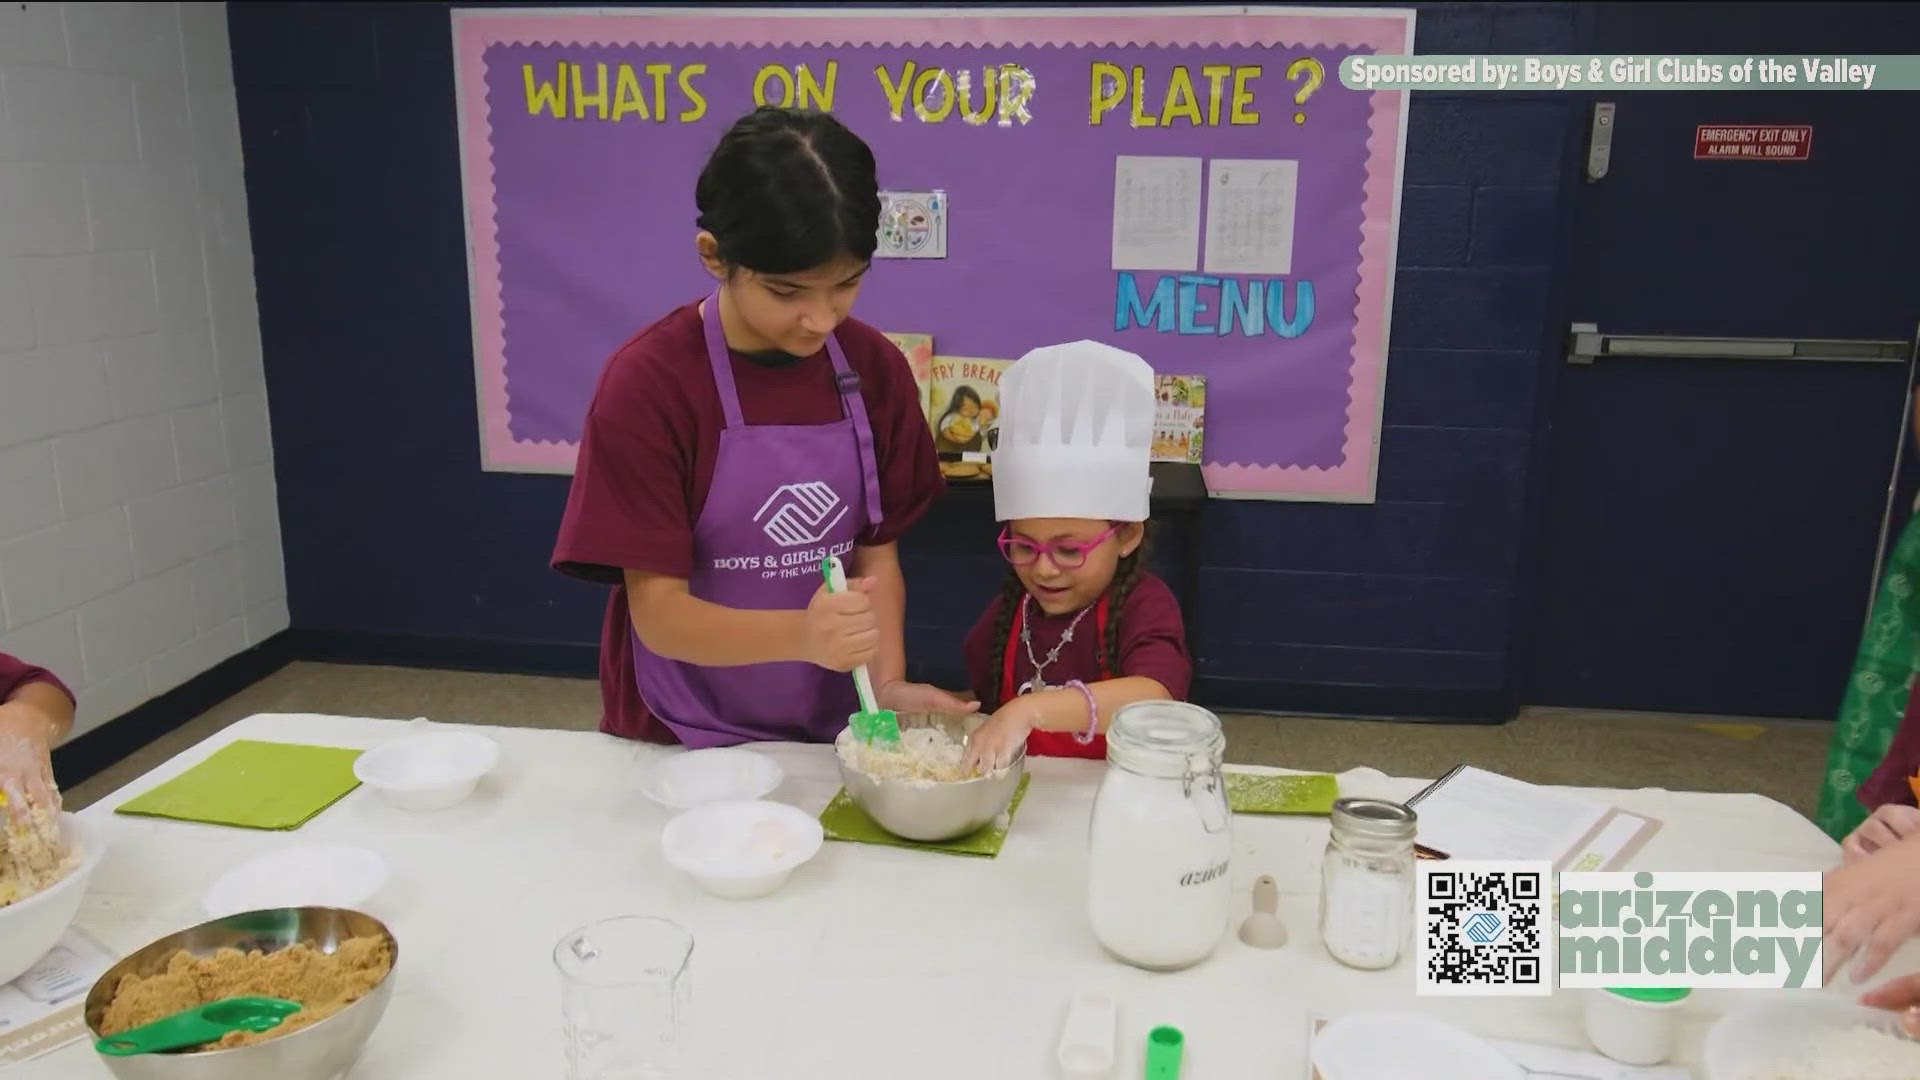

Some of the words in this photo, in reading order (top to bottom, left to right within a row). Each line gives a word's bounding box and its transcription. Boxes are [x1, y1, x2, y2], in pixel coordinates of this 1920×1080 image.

[522, 60, 708, 123] WHATS
[752, 58, 838, 113] ON
[873, 61, 1037, 128] YOUR
[1088, 62, 1264, 129] PLATE
[1286, 56, 1326, 127] ?
[1700, 128, 1758, 142] EMERGENCY
[1759, 129, 1780, 142] EXIT
[1782, 129, 1808, 142] ONLY
[1708, 144, 1740, 155] ALARM
[1742, 145, 1764, 155] WILL
[1765, 145, 1797, 156] SOUND
[1114, 271, 1316, 339] MENU
[932, 362, 955, 382] FRY
[713, 556, 760, 570] BOYS
[763, 554, 779, 569] &
[781, 546, 826, 566] GIRLS
[761, 571, 777, 580] OF
[780, 567, 799, 579] THE
